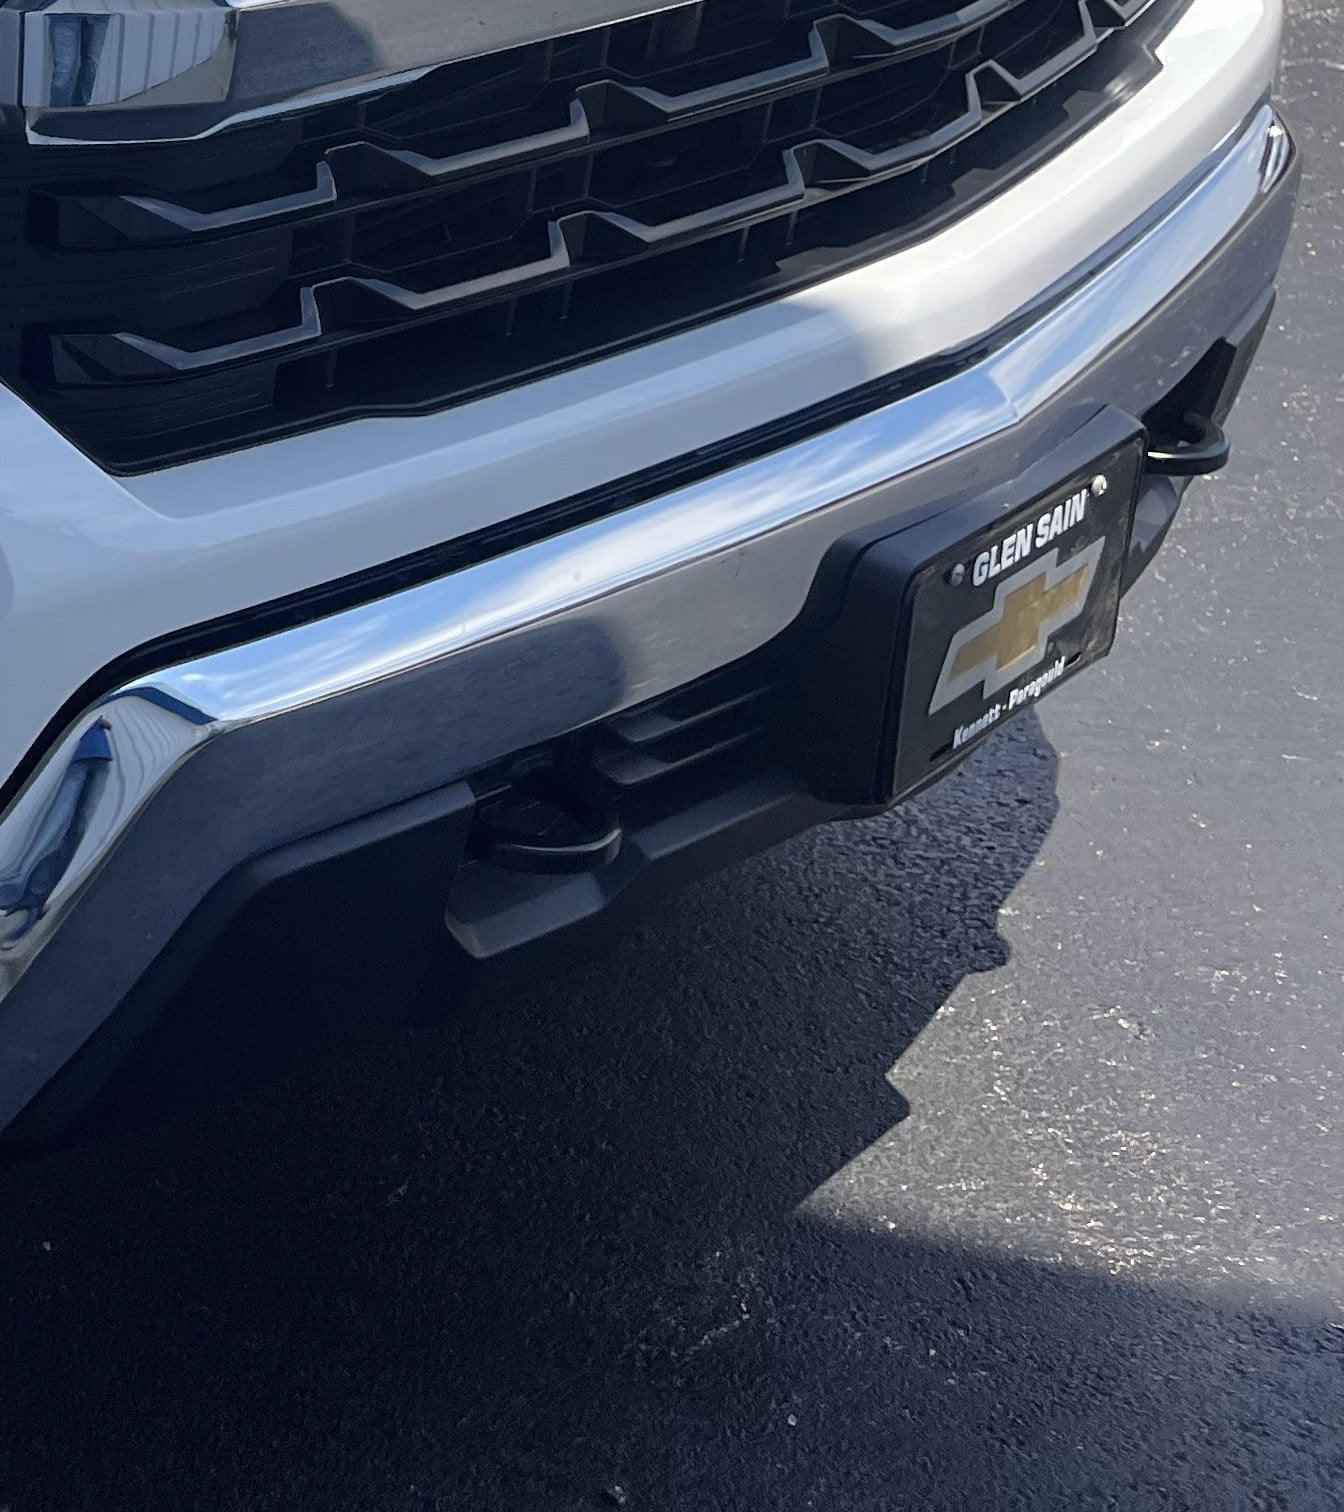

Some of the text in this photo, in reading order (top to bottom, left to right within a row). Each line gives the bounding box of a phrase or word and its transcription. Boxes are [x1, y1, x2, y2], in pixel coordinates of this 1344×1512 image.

[972, 488, 1089, 587] GLEN SAIN
[953, 655, 1066, 749] Kennett Paragould
